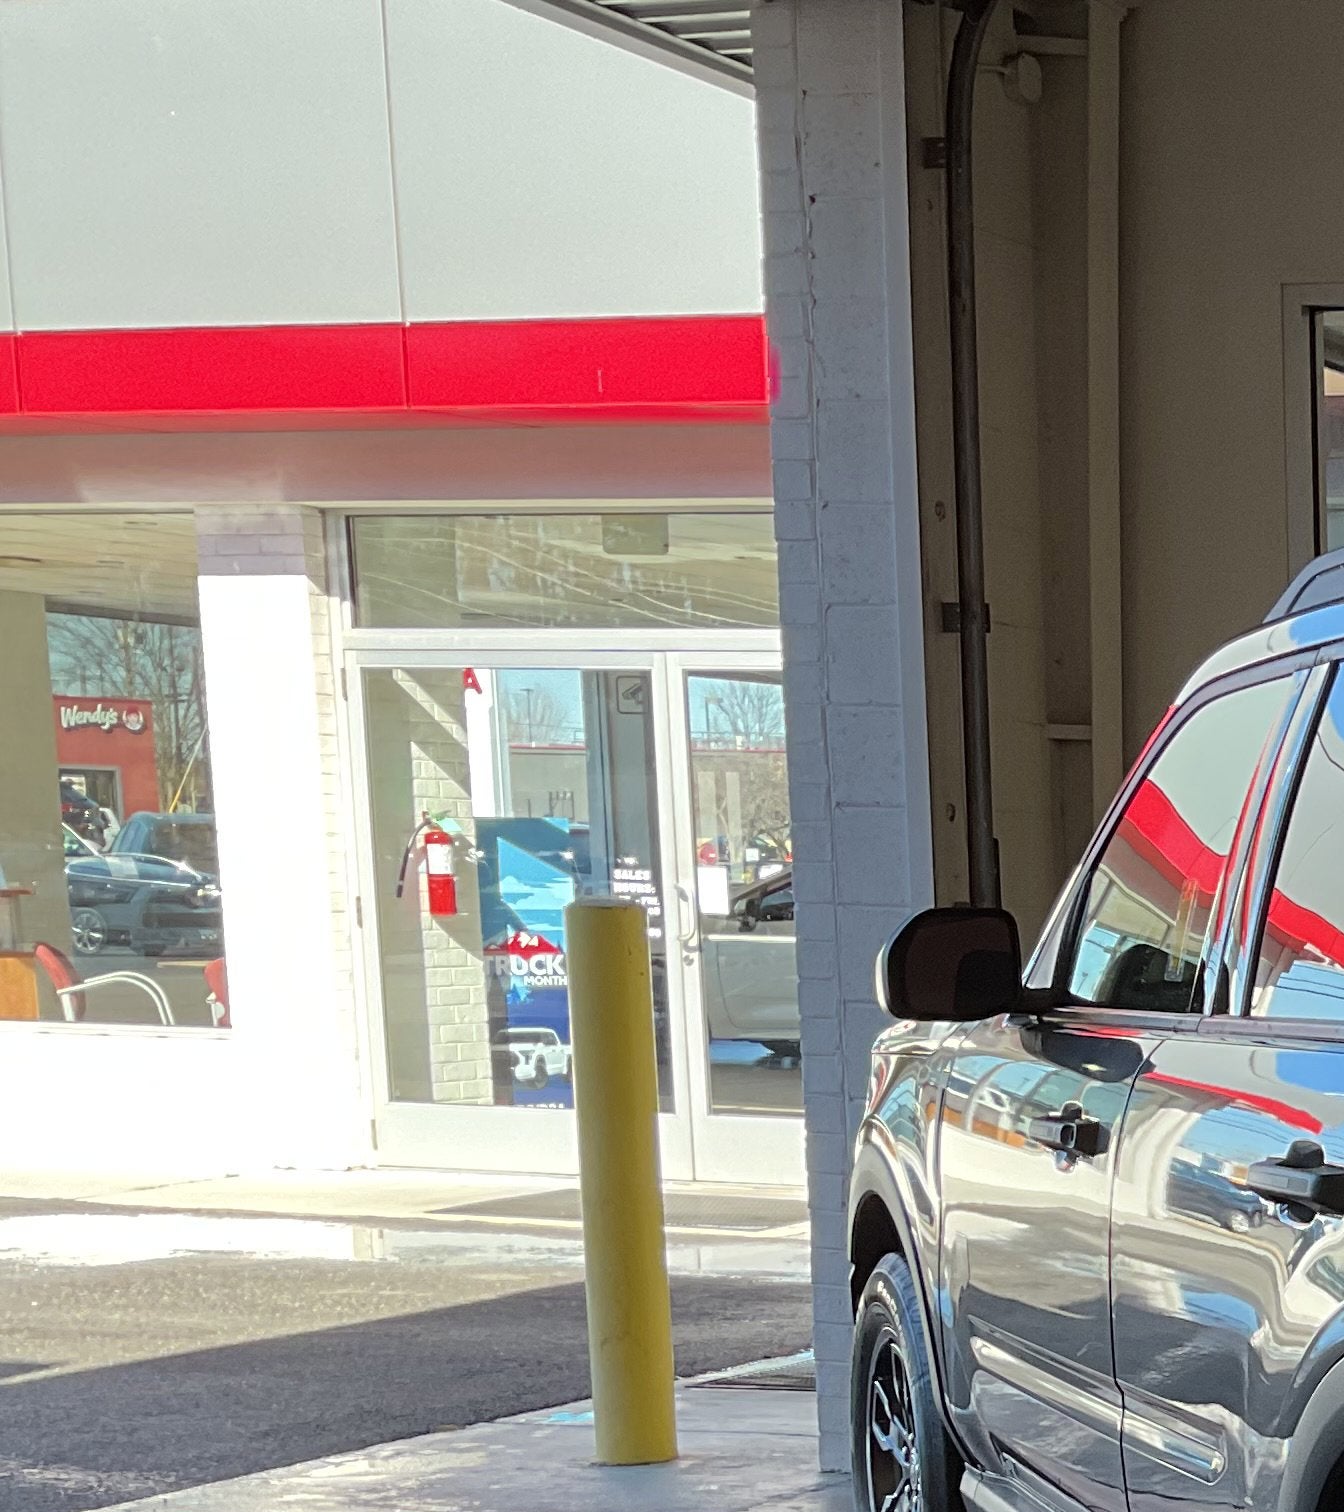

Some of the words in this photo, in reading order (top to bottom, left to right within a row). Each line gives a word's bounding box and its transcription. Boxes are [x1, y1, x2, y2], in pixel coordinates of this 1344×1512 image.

[60, 703, 118, 730] Wendy's
[483, 954, 565, 976] TRUCK
[524, 975, 568, 986] MONTH
